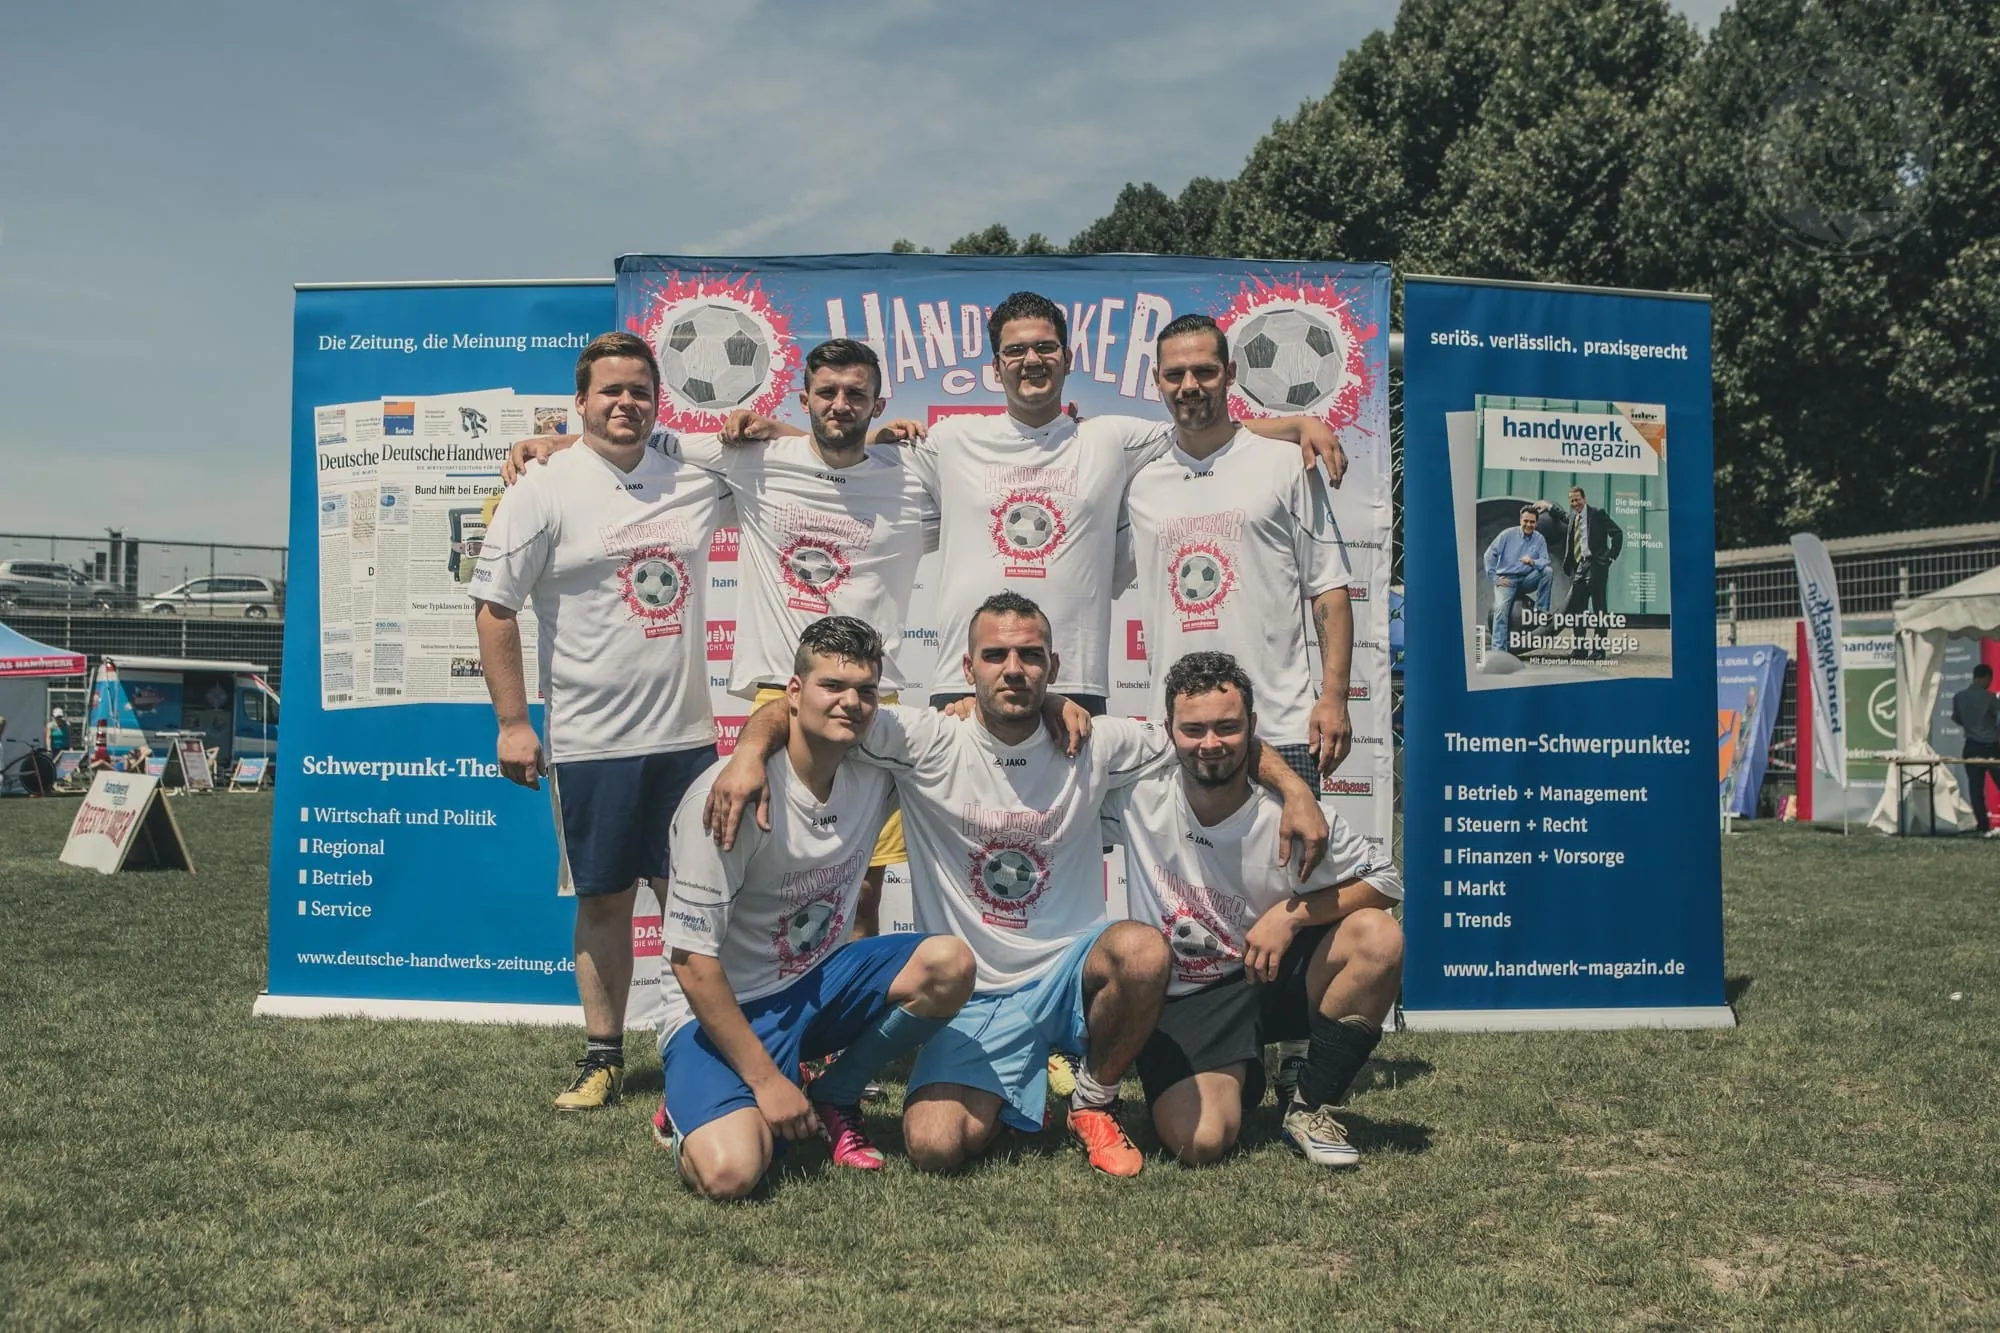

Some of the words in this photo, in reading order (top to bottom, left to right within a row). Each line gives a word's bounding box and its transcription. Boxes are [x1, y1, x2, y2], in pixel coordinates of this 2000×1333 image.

[319, 335, 346, 351] Die
[349, 334, 418, 354] Zeitung,
[423, 334, 449, 350] die
[452, 334, 527, 352] Meinung
[531, 332, 590, 349] macht!
[826, 291, 1173, 402] HANDKER
[1430, 329, 1484, 348] seriös.
[1489, 333, 1578, 354] verlässlich.
[1583, 339, 1689, 361] praxisgerecht
[1502, 416, 1623, 442] handwerk
[319, 448, 380, 471] Deutsche
[382, 443, 446, 462] Deutsche
[1561, 439, 1642, 461] magazin
[825, 475, 846, 484] JAKO
[1194, 471, 1214, 479] JAKO
[415, 485, 437, 495] Bund
[439, 484, 456, 495] hilft
[457, 485, 471, 495] bei
[473, 485, 506, 496] Energie
[1521, 608, 1547, 626] Die
[1553, 610, 1627, 630] perfekte
[1509, 631, 1640, 654] Bilanzstrategie
[1444, 732, 1691, 758] Themen-Schwerpunkte:
[1004, 758, 1027, 767] JAKO
[1458, 785, 1518, 801] Betrieb
[1523, 788, 1534, 800] +
[1539, 786, 1648, 805] Management
[313, 807, 401, 825] Wirtschaft
[405, 809, 439, 825] und
[443, 809, 497, 827] Politik
[819, 815, 838, 826] JAKO
[1457, 817, 1520, 834] Steuern
[1526, 820, 1537, 831] +
[1542, 817, 1588, 834] Recht
[312, 838, 385, 859] Regional
[1458, 848, 1532, 865] Finanzen
[1538, 851, 1549, 863] +
[1553, 849, 1625, 868] Vorsorge
[312, 869, 373, 886] Betrieb
[1458, 879, 1506, 896] Markt
[311, 901, 372, 918] Service
[1456, 912, 1512, 928] Trends
[297, 951, 576, 975] www.deutsche-handwerks-zeitung.de
[1443, 958, 1686, 979] www.handwerk-magazin.de
